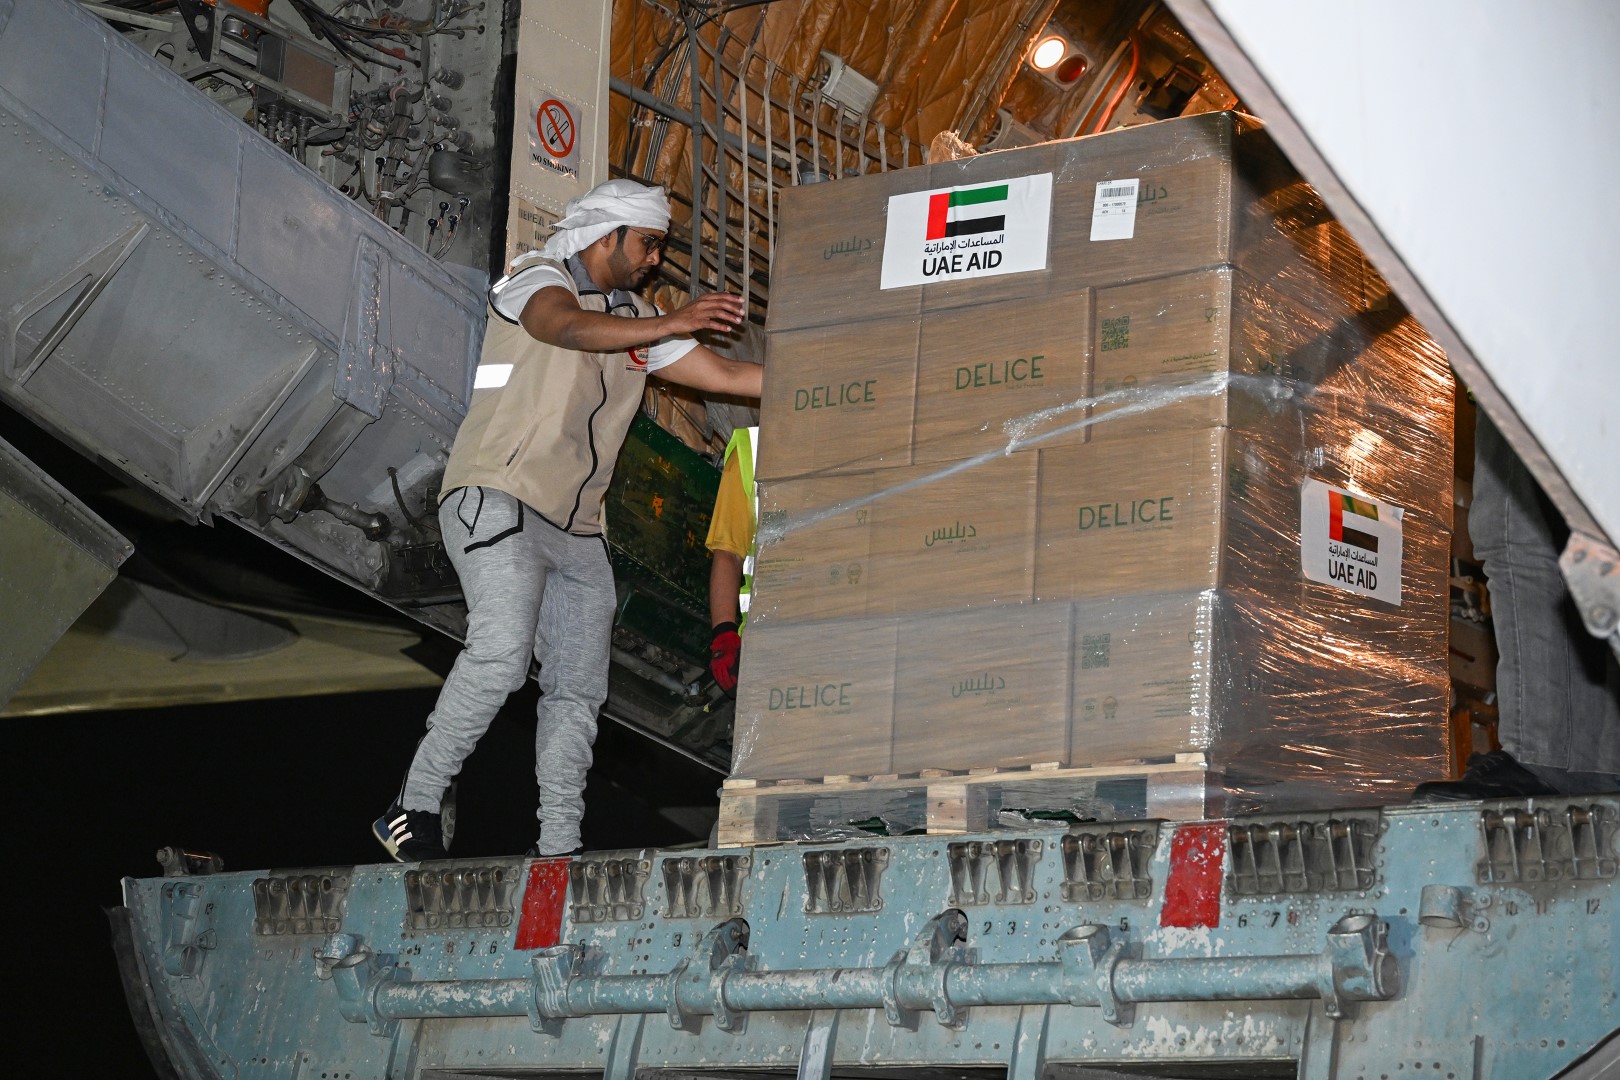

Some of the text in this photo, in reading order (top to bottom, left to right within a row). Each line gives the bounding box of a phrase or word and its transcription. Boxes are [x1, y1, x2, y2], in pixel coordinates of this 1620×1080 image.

[532, 153, 542, 163] NO
[823, 235, 872, 261] ديليس
[924, 234, 1005, 256] المساعدات الإماراتية
[922, 250, 1003, 277] UAE AID
[955, 355, 1045, 390] DELICE
[794, 379, 877, 411] DELICE
[1078, 496, 1174, 530] DELICE
[925, 521, 977, 547] ديليس
[1328, 558, 1377, 591] UAE AID
[768, 683, 852, 711] DELICE
[951, 672, 1006, 699] ديليس
[983, 921, 992, 935] 2
[1007, 921, 1016, 935] 3
[1120, 916, 1128, 931] 5
[1238, 914, 1247, 928] 6
[1270, 912, 1280, 928] 7
[489, 940, 498, 954] 6
[673, 933, 682, 947] 3
